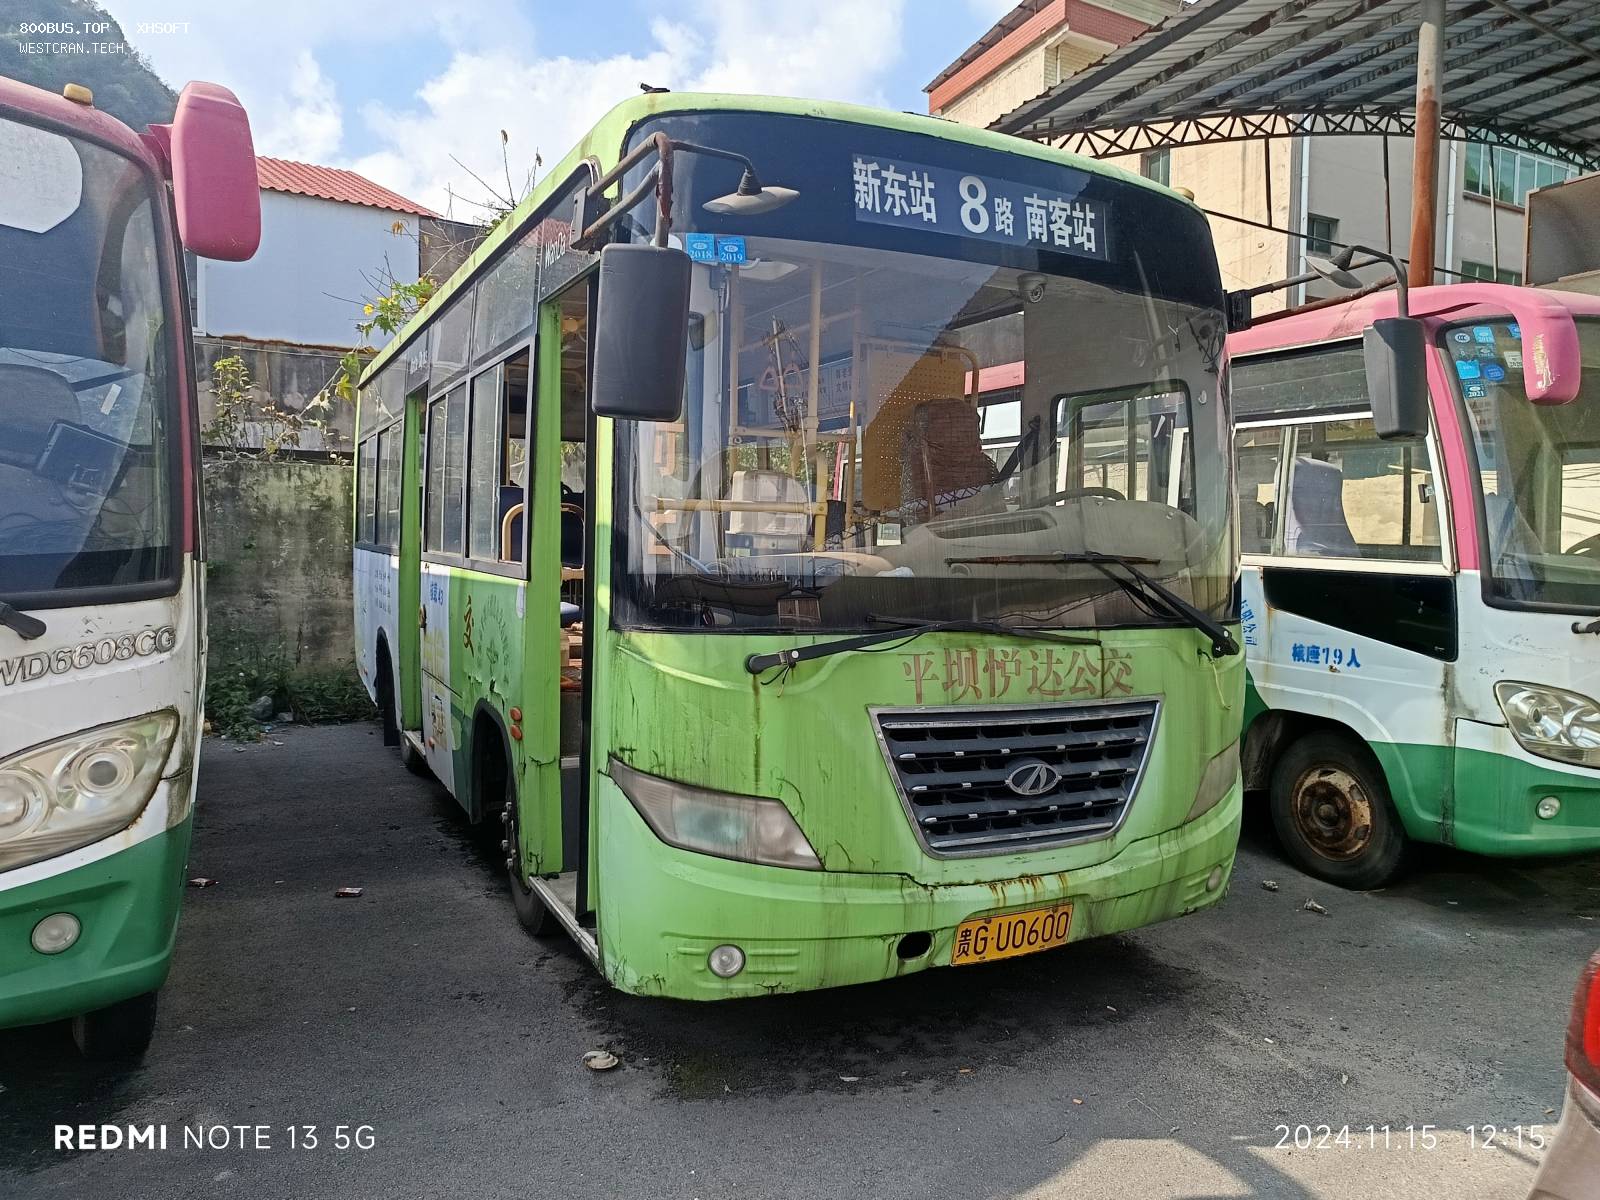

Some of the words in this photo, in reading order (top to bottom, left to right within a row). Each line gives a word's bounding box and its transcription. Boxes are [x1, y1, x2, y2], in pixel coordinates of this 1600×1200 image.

[852, 158, 937, 224] 新东站
[1023, 192, 1096, 253] 南客站
[720, 252, 743, 262] 2019
[896, 647, 1134, 704] 平坝悦达公交
